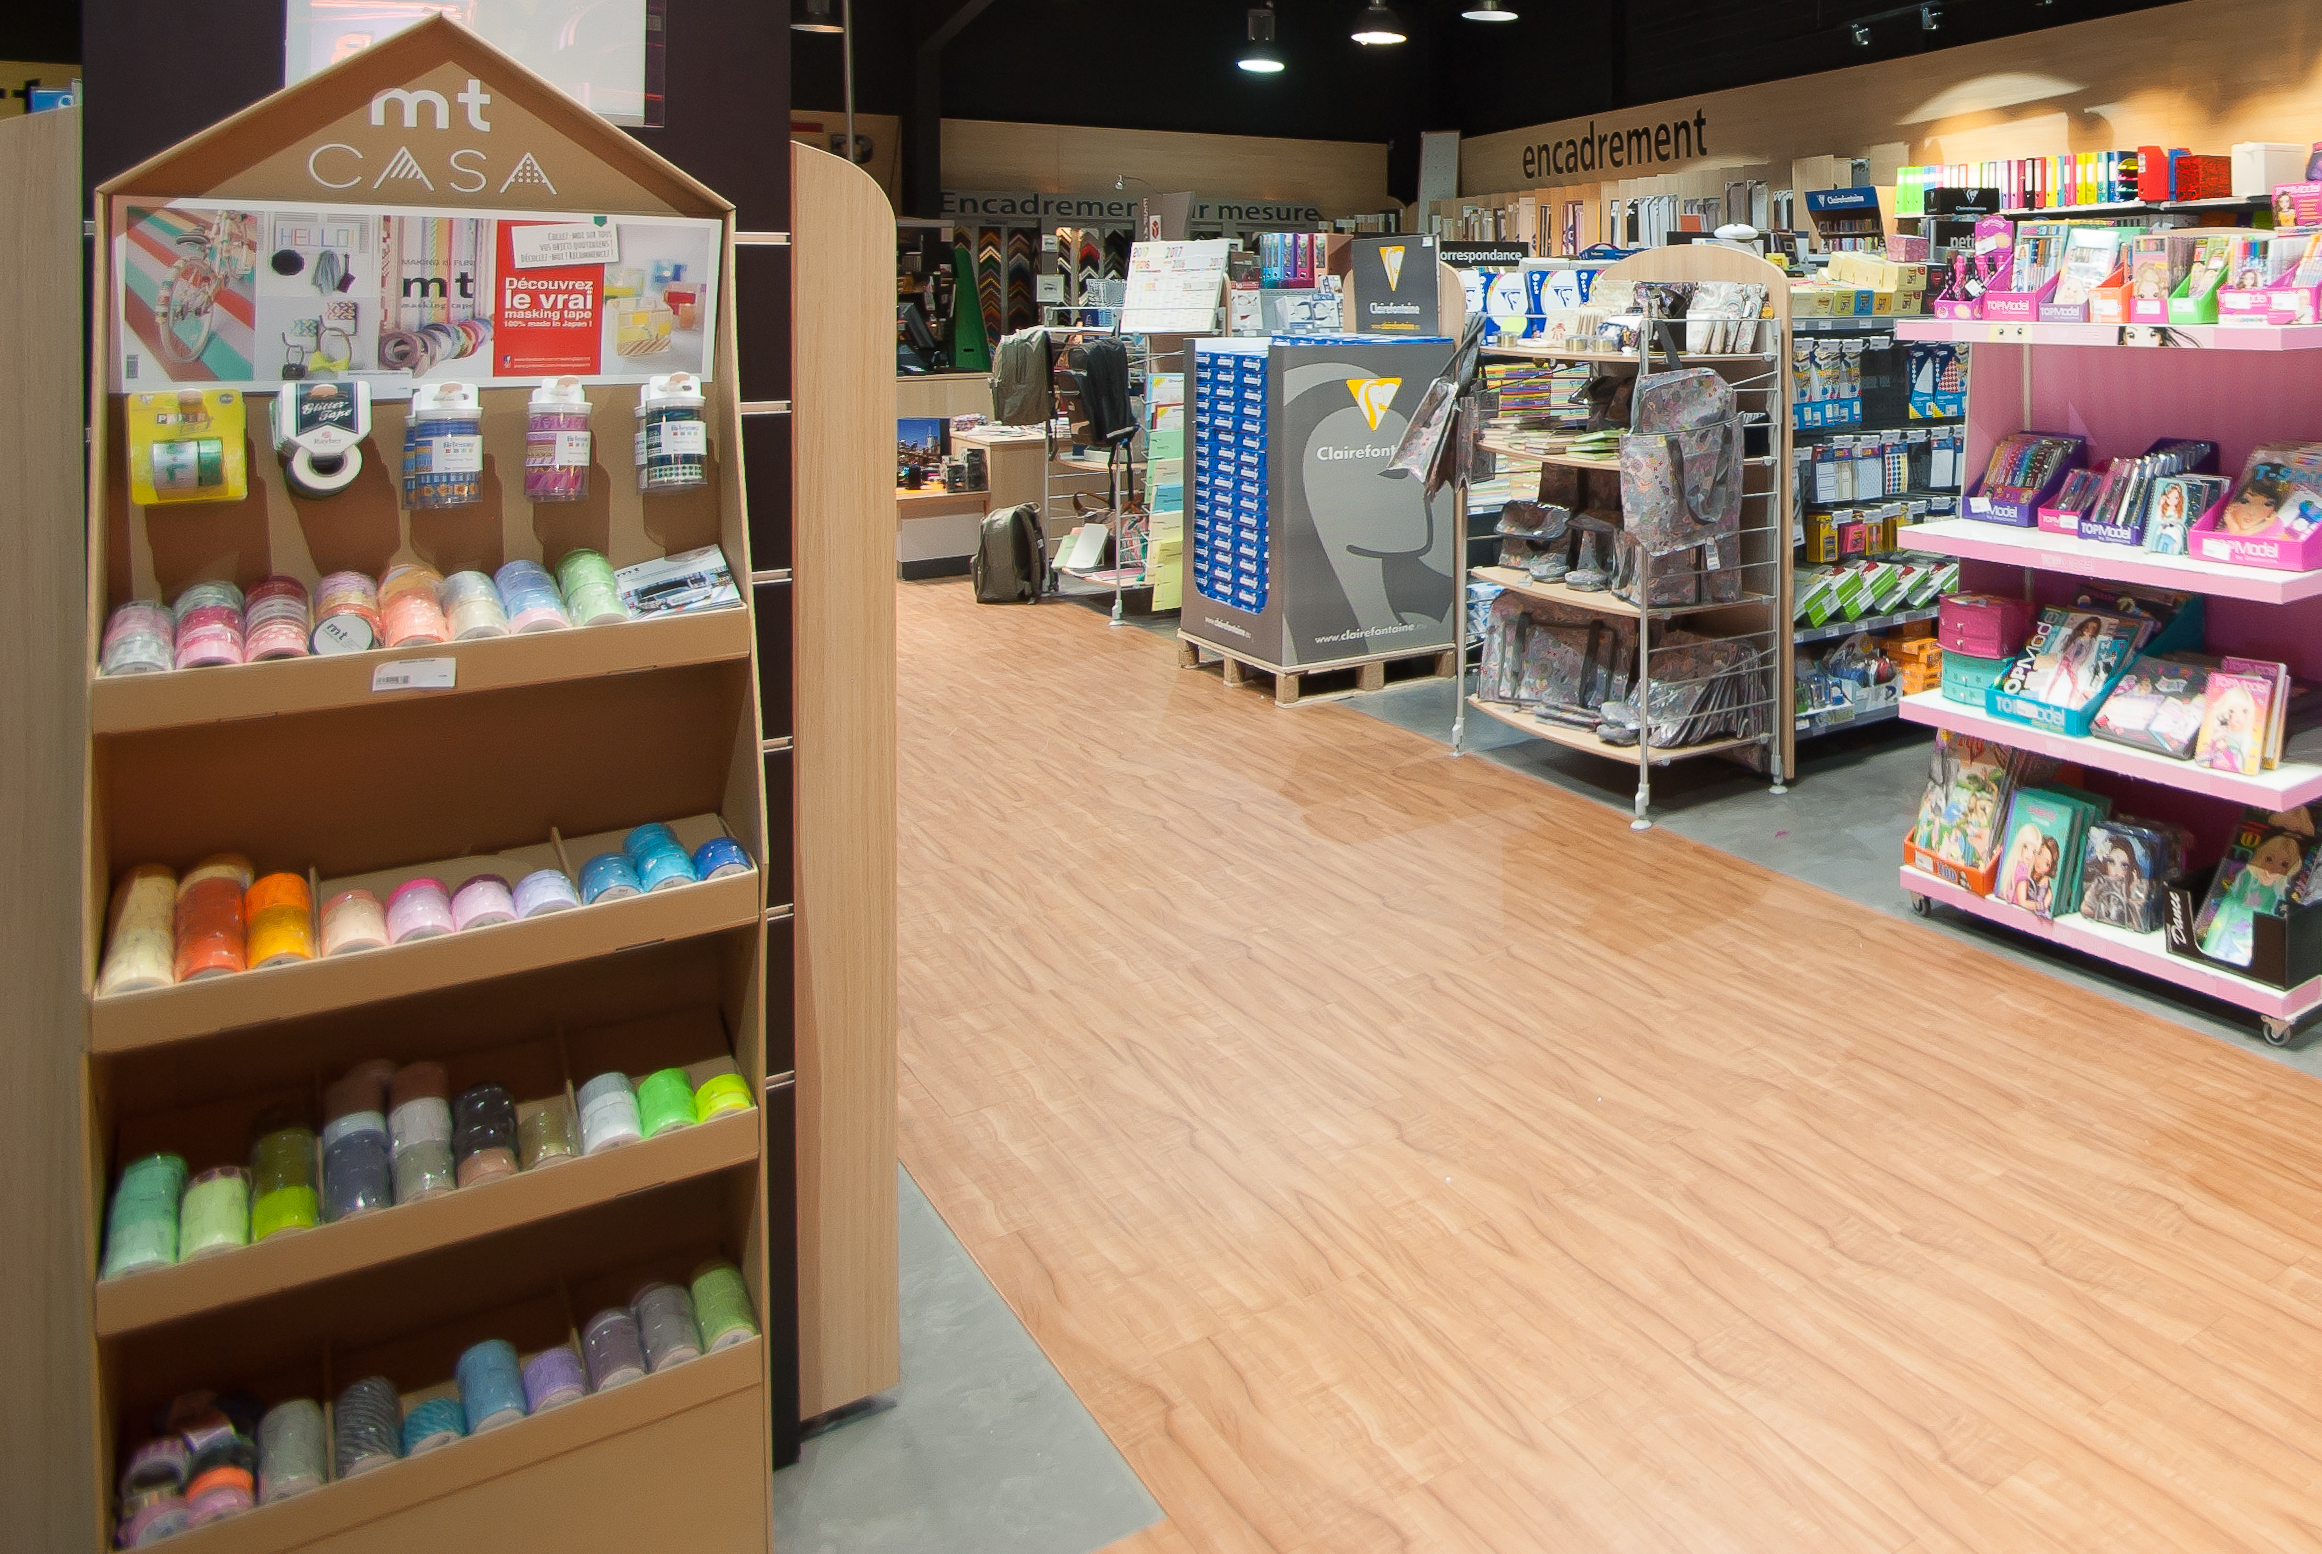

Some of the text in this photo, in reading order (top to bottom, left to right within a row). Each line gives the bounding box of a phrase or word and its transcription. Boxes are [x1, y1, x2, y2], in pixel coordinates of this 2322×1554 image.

[370, 79, 491, 132] mt
[1522, 108, 1707, 179] encadrement
[308, 143, 557, 195] CASA
[1218, 203, 1319, 222] mesure
[402, 272, 474, 298] mt
[505, 277, 594, 290] Découvrez
[505, 289, 593, 310] le vrai
[504, 309, 593, 321] masking tape
[1987, 505, 2018, 518] Model
[2081, 522, 2132, 540] TOPModel
